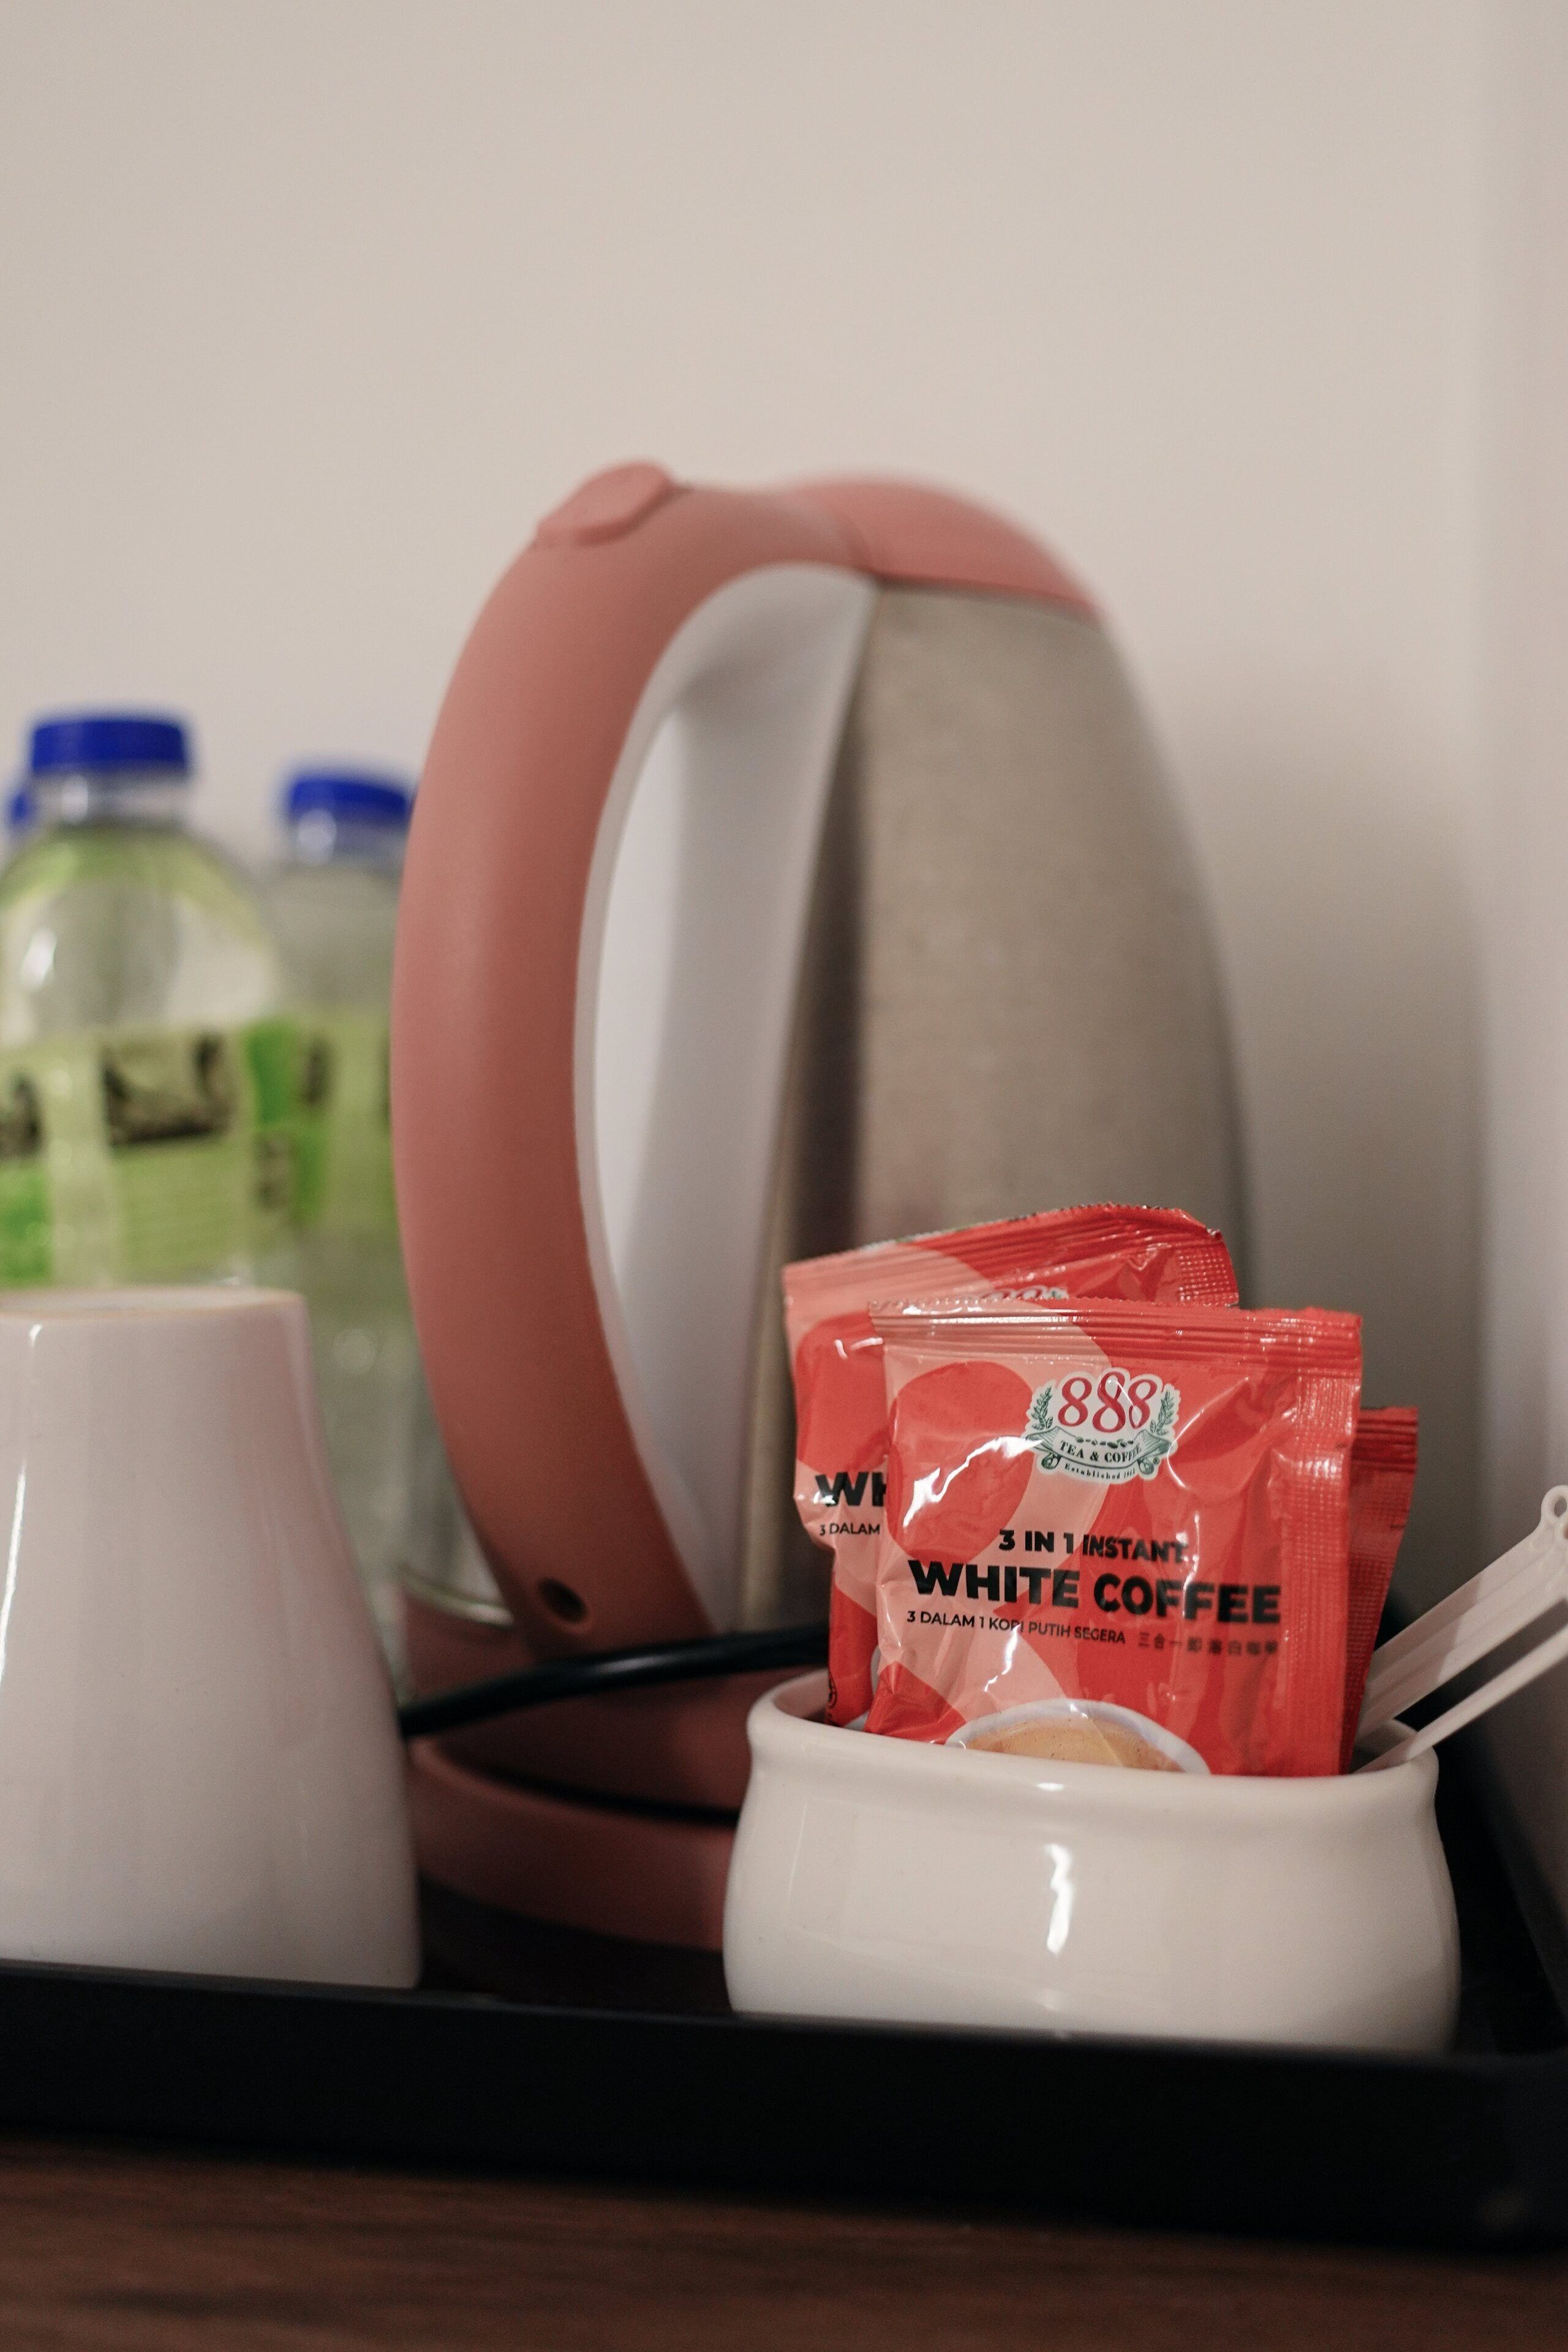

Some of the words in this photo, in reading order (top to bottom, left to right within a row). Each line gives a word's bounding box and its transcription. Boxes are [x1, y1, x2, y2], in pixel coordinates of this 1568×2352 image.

[1058, 1371, 1157, 1433] 888
[1060, 1441, 1084, 1459] TEA
[1090, 1451, 1099, 1462] &
[1104, 1443, 1142, 1463] COFFEE
[1065, 1463, 1120, 1480] Established
[820, 1524, 826, 1536] 3
[830, 1523, 880, 1535] DALAM
[999, 1529, 1016, 1551] 3
[1025, 1531, 1054, 1553] IN
[1063, 1532, 1074, 1554] 1
[1082, 1534, 1188, 1563] INSTANT
[908, 1559, 1080, 1608] WHITE
[1093, 1573, 1281, 1623] COFFEE
[907, 1611, 916, 1623] 3
[921, 1611, 974, 1628] DALAM
[980, 1616, 984, 1629] 1
[989, 1617, 1024, 1633] KOPI
[1028, 1621, 1071, 1638] PUTIH
[1074, 1626, 1125, 1644] SEGERA
